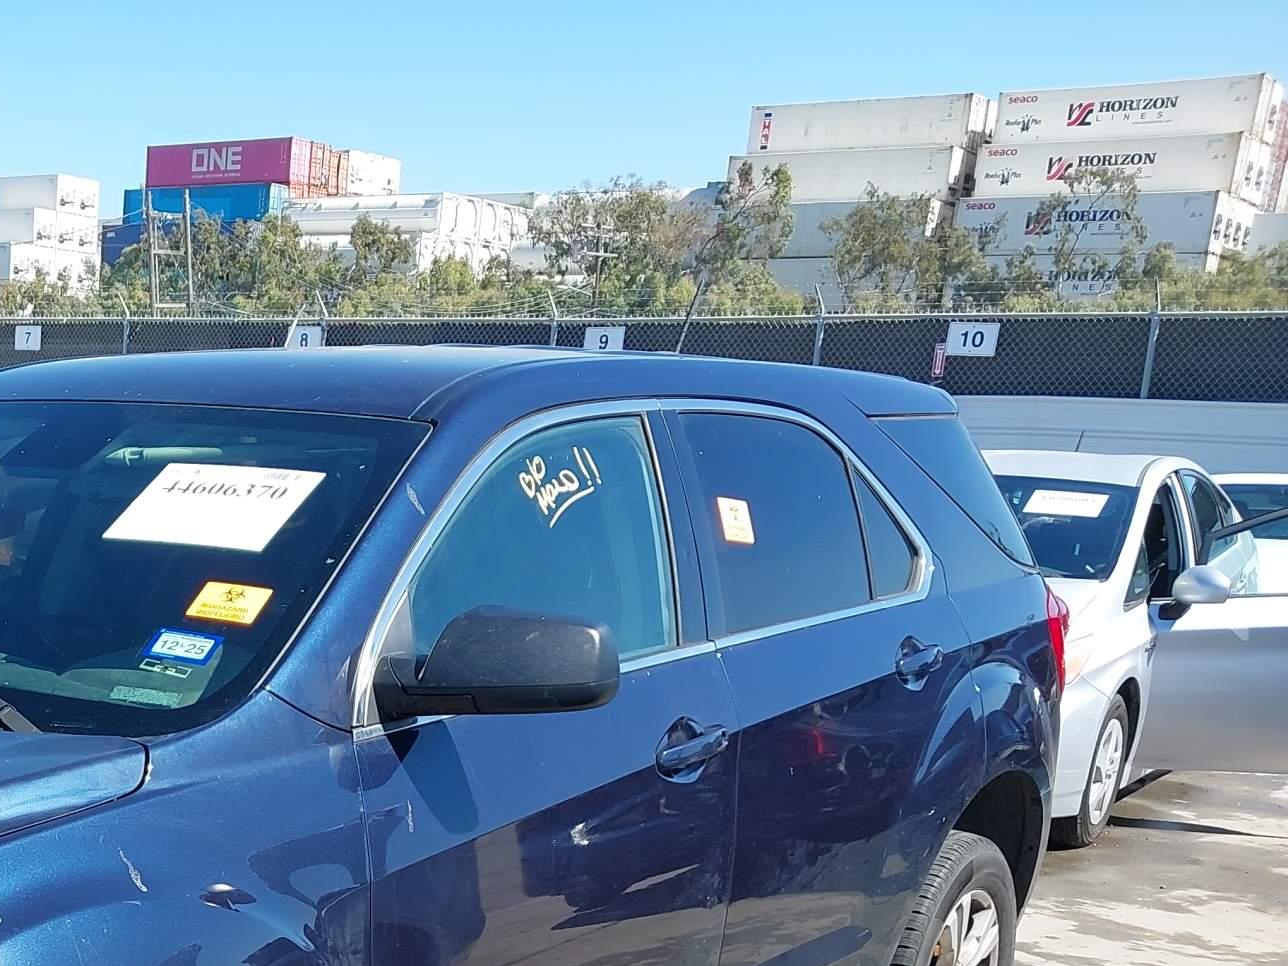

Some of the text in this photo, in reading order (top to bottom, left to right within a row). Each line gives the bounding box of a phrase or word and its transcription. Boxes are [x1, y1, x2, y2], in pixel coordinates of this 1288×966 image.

[1008, 95, 1038, 104] seaco
[1098, 96, 1180, 113] HORIZON
[1096, 111, 1164, 122] LINES
[192, 147, 242, 171] ONE
[988, 148, 1018, 157] seaco
[1077, 152, 1157, 167] HORIZON
[965, 201, 996, 210] seaco
[25, 332, 31, 344] 7
[300, 333, 308, 347] 8
[599, 334, 608, 349] 9
[960, 330, 985, 348] 10
[163, 480, 288, 499] 44606370
